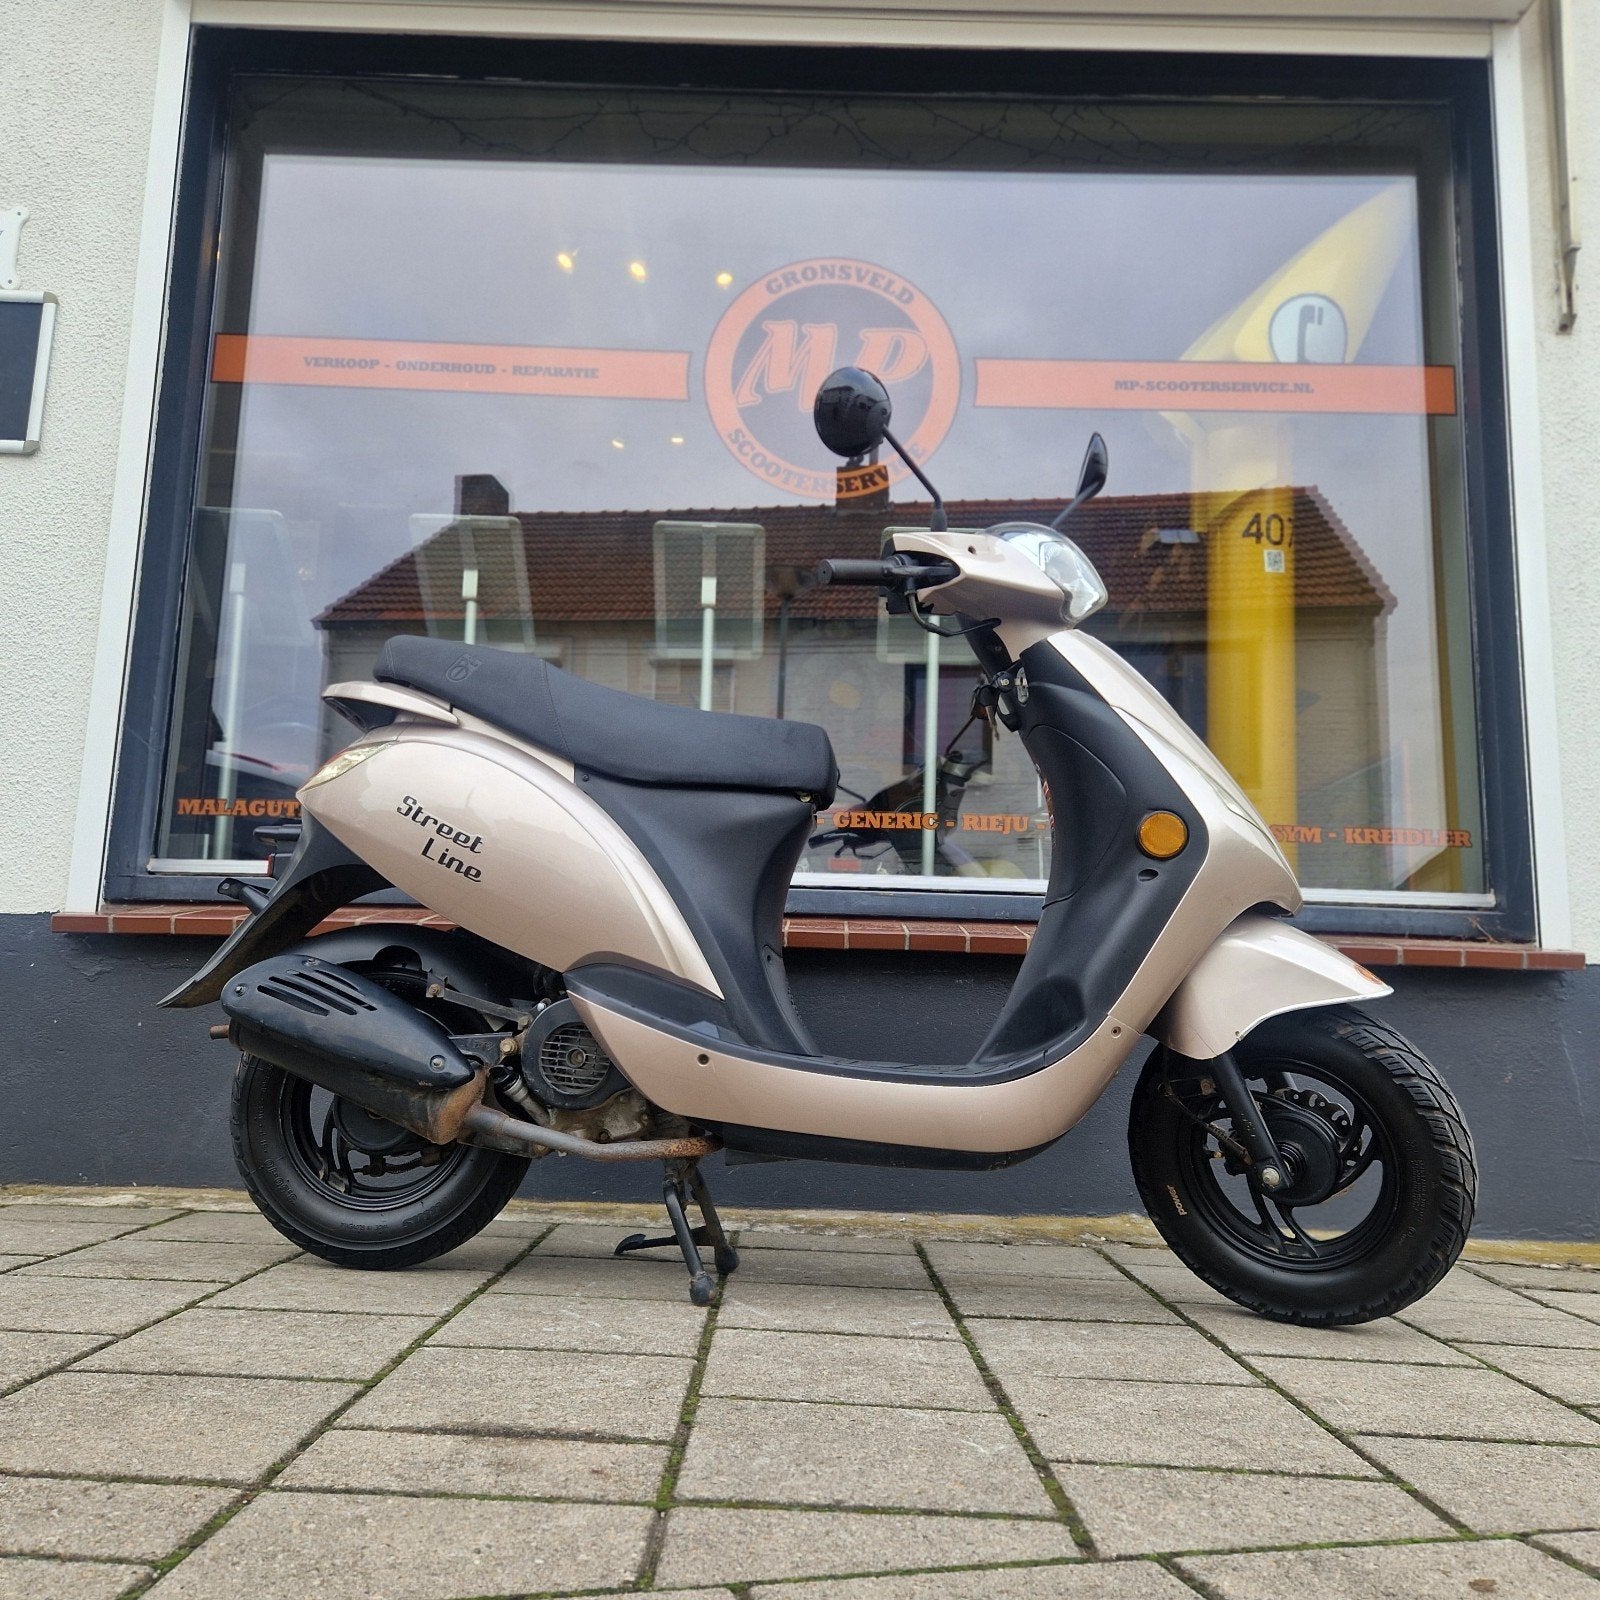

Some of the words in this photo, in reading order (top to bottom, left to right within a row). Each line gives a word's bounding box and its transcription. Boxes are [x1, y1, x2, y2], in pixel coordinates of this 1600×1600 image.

[765, 264, 915, 306] GRONSVELD
[303, 356, 380, 370] VERKOOP
[396, 360, 496, 374] ONDERHOUD
[512, 364, 599, 379] REPARATIE
[734, 318, 929, 413] MP
[1114, 380, 1315, 394] MP-SCOOTERSERVICE.NL
[728, 428, 926, 494] SCOOTERSERVIE
[396, 795, 483, 854] Street
[832, 811, 939, 831] GENERIC
[963, 813, 1029, 835] RIEJU
[1269, 824, 1322, 844] SYM
[1344, 827, 1473, 848] KREIDLER
[421, 837, 482, 883] Line
[1166, 1184, 1188, 1216] power
